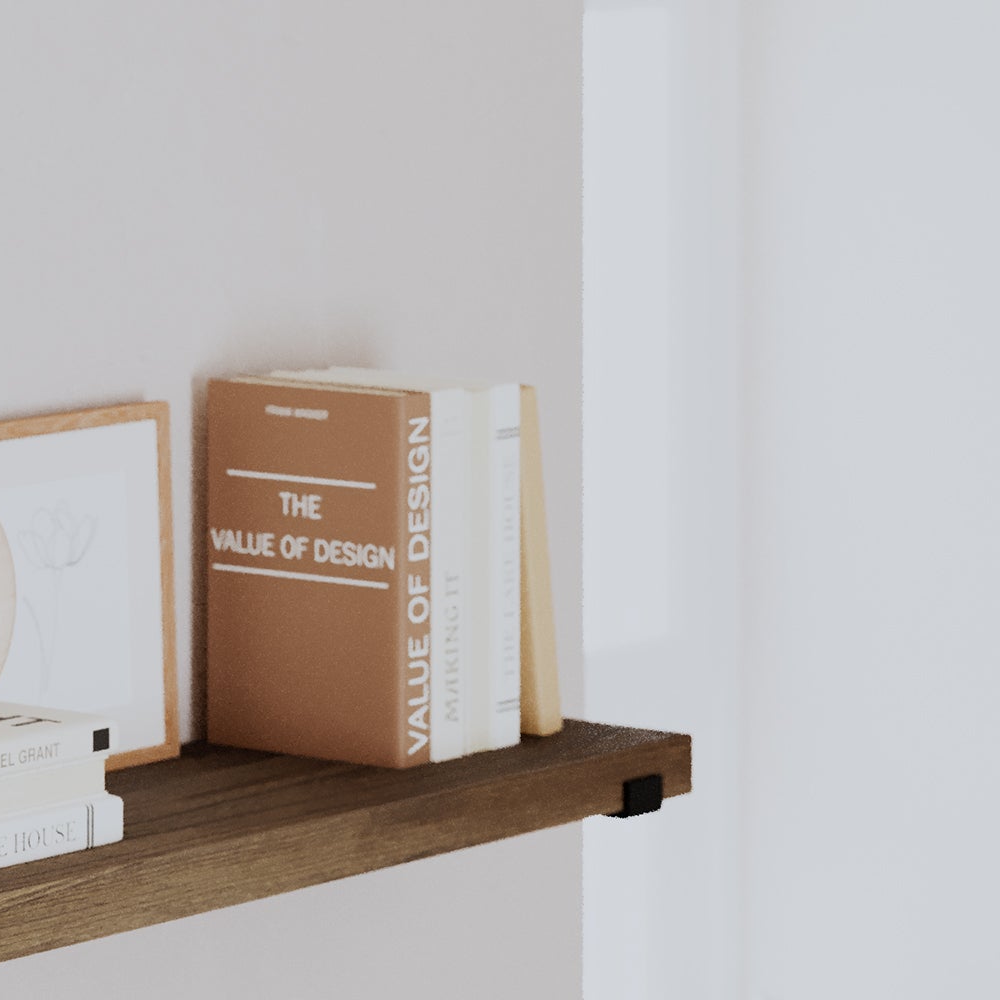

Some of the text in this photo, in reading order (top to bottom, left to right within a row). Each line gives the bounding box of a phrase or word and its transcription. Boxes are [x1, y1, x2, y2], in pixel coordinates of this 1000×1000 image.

[278, 491, 322, 520] THE
[210, 527, 396, 570] VALUE OF DESIGN
[407, 416, 430, 756] VALUE OF DESIGN
[445, 570, 460, 723] MAKING IT
[18, 742, 62, 765] GRANT
[13, 820, 77, 854] HOUSE
